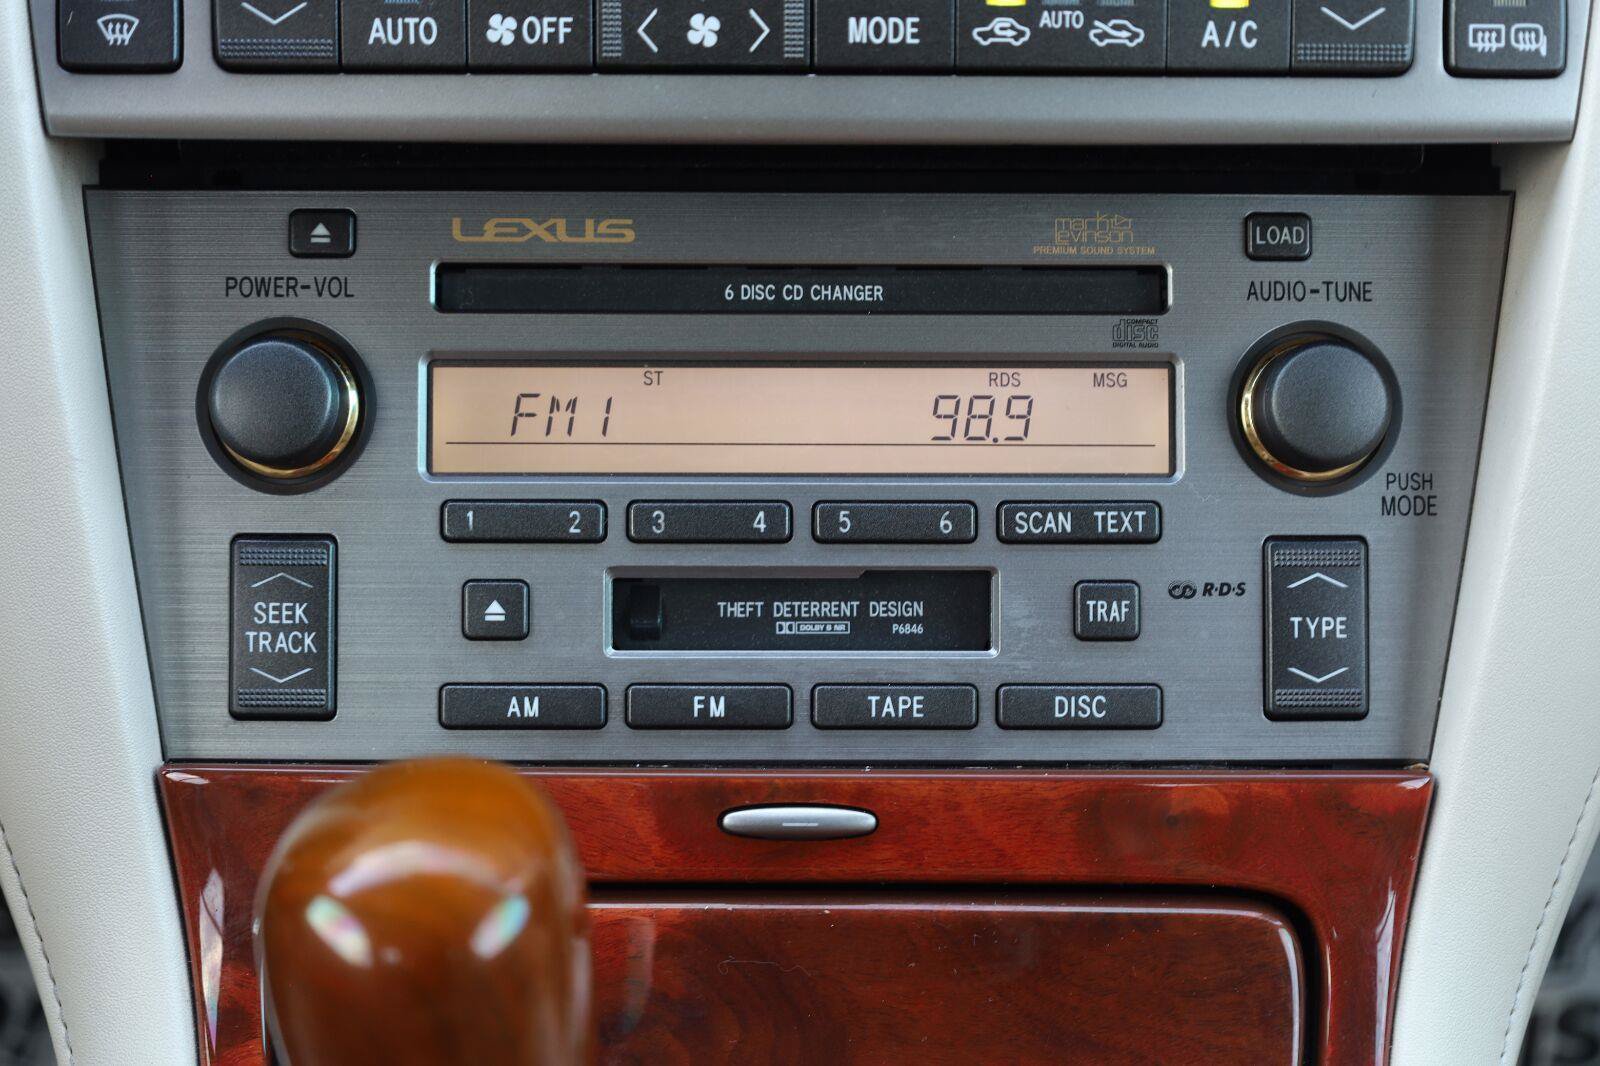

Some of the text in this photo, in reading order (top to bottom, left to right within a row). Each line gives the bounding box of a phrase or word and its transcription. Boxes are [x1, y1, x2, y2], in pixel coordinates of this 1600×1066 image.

[522, 16, 573, 44] OFF
[848, 17, 920, 44] MODE
[1039, 11, 1084, 29] AUTO
[369, 17, 437, 45] AUTO
[1202, 20, 1257, 48] A/C
[452, 218, 635, 243] LEXUS
[1256, 226, 1306, 245] LOAD
[1033, 245, 1156, 254] PREMIUM SOUND SYSTEM
[725, 284, 883, 301] 6 DISC CD CHANGER
[1112, 318, 1158, 341] disc
[643, 371, 663, 386] ST
[989, 373, 1021, 387] RDS
[1093, 373, 1128, 387] MSG
[931, 395, 1034, 442] 98.9
[1387, 473, 1434, 490] PUSH
[1382, 495, 1437, 516] MODE
[467, 511, 473, 530] 1
[569, 511, 581, 533] 2
[653, 510, 665, 533] 3
[753, 511, 766, 532] 4
[839, 511, 851, 533] 5
[940, 511, 952, 533] 6
[1015, 511, 1071, 533] SCAN
[1094, 511, 1146, 532] TEXT
[254, 602, 308, 624] SEEK
[717, 601, 923, 617] THEFT DETERRENT DESIGN
[1087, 601, 1130, 622] TRAF
[893, 623, 923, 634] P6846
[1290, 617, 1347, 638] TYPE
[245, 631, 316, 653] TRACK
[507, 696, 538, 717] AM
[694, 696, 724, 717] FM
[868, 696, 924, 717] TAPE
[1055, 695, 1106, 718] DISC
